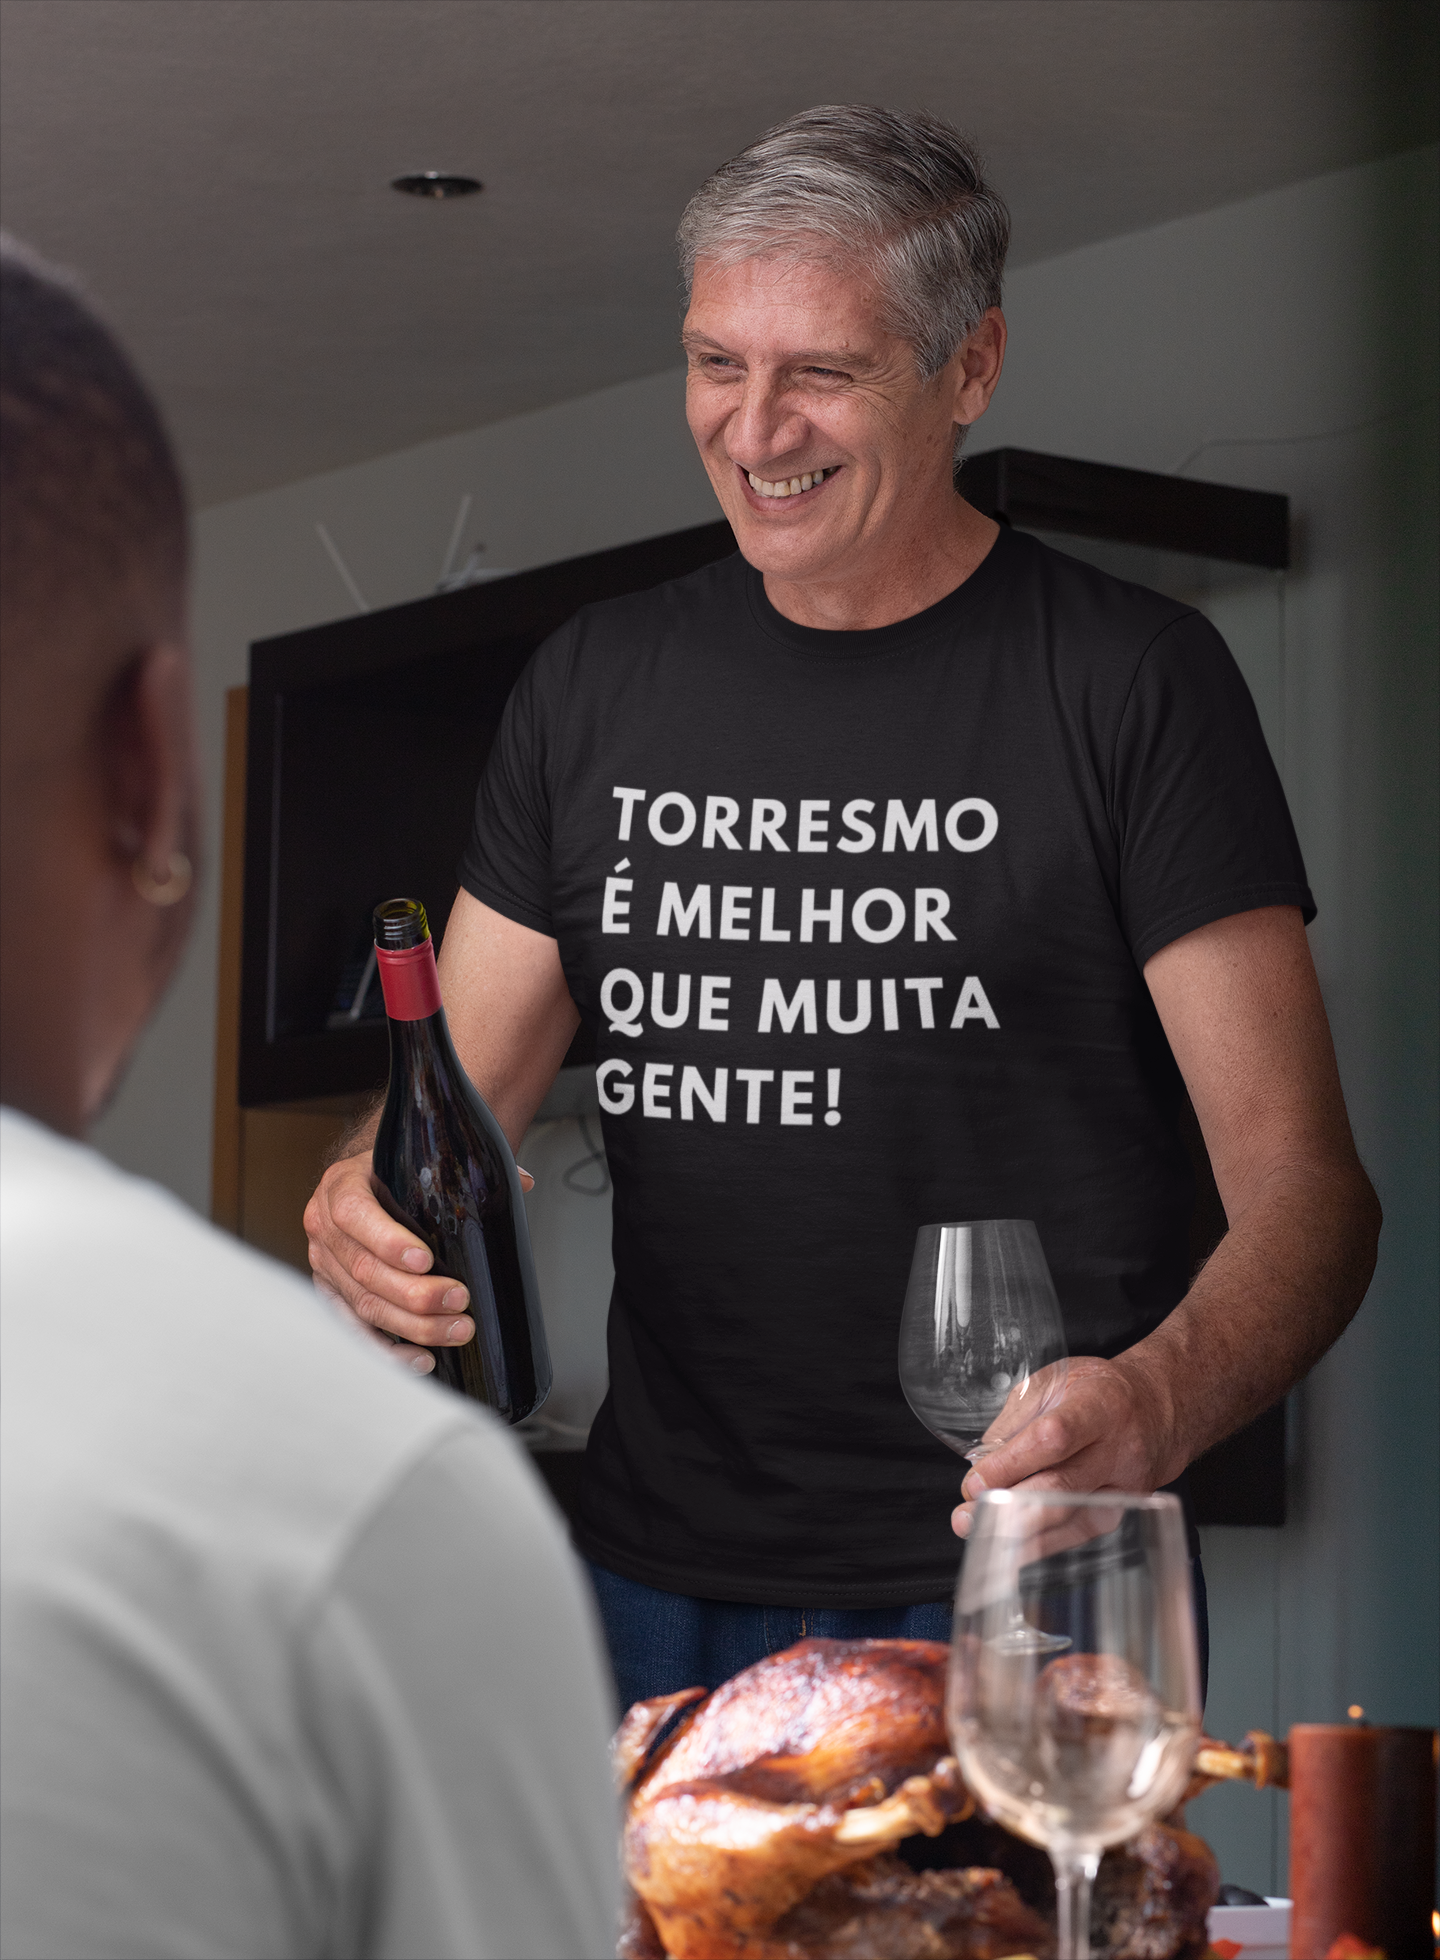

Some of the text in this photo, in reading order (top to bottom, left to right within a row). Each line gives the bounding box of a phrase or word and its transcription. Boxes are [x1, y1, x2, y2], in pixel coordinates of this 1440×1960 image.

[612, 786, 999, 853] TORRESMO
[601, 857, 958, 943] É MELHOR
[600, 967, 1001, 1038] QUE MUITA
[595, 1058, 842, 1127] GENTE!
